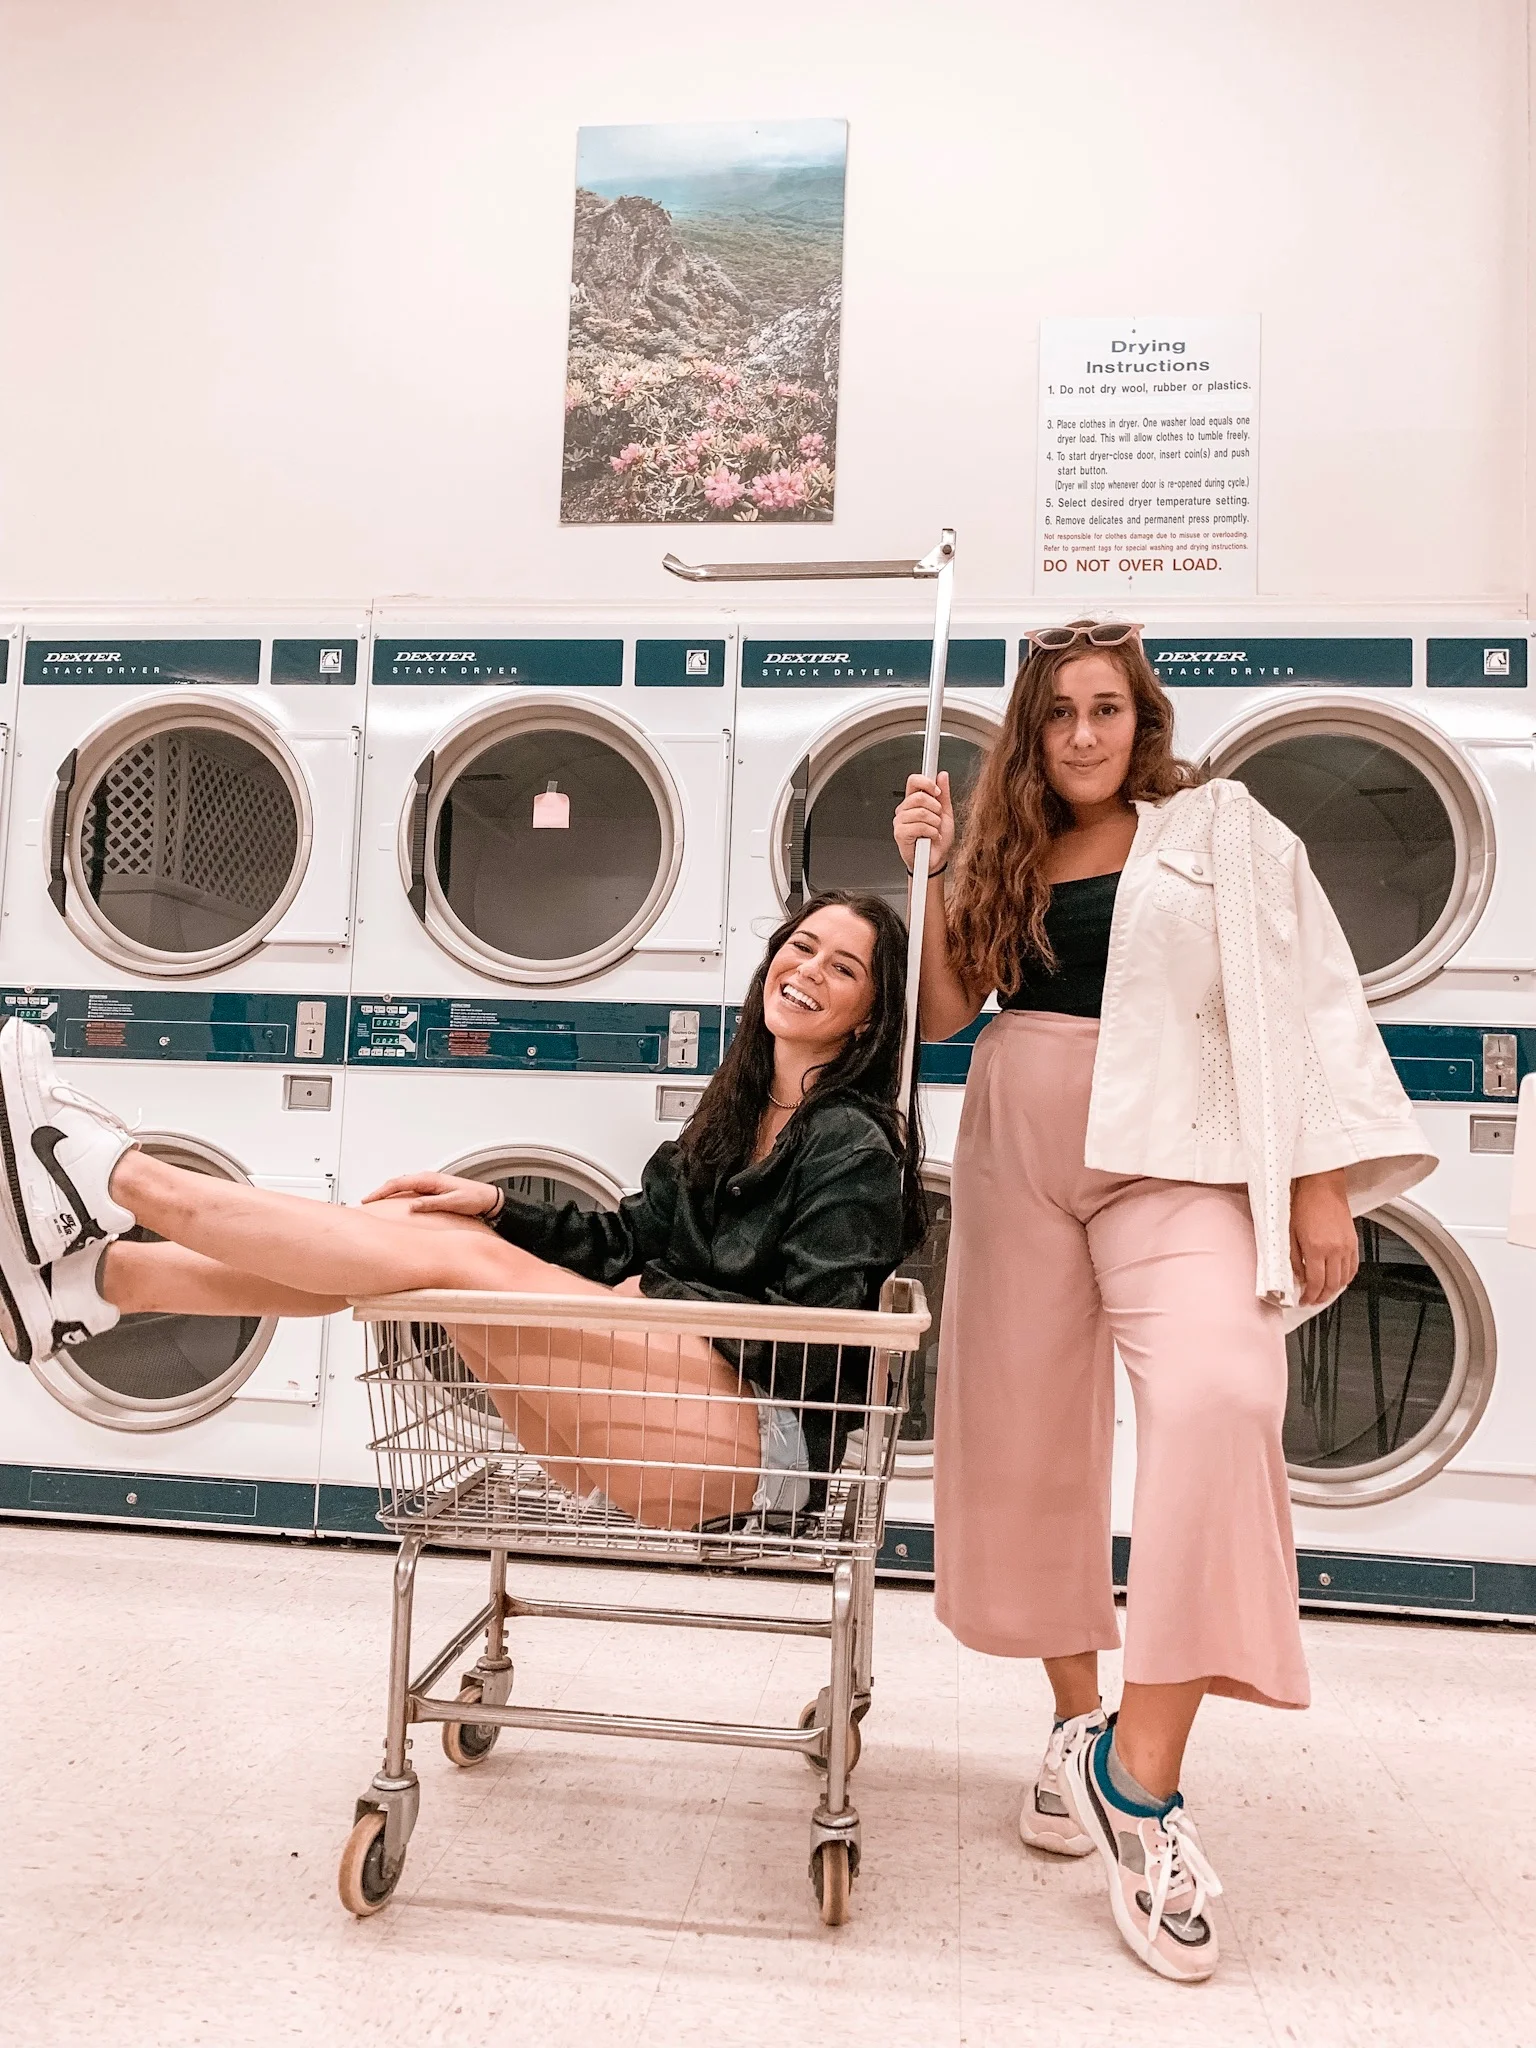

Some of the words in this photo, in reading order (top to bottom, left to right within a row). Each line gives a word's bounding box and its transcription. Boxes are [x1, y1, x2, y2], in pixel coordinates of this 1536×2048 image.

[1111, 340, 1186, 354] Drying
[1086, 359, 1210, 374] Instructions
[1048, 385, 1055, 394] 1.
[1060, 385, 1073, 394] Do
[1079, 385, 1095, 394] not
[1100, 384, 1116, 395] dry
[1122, 383, 1148, 394] wool,
[1153, 382, 1187, 392] rubber
[1192, 383, 1202, 391] or
[1208, 380, 1251, 392] plastics.
[1047, 420, 1053, 429] 3.
[1057, 420, 1076, 429] Place
[1080, 419, 1106, 428] clothes
[1109, 419, 1115, 428] in
[1118, 419, 1139, 429] dryer.
[1143, 417, 1157, 427] One
[1161, 417, 1186, 426] washer
[1190, 417, 1205, 426] load
[1209, 416, 1233, 427] equals
[1236, 417, 1250, 425] one
[1057, 434, 1076, 445] dryer
[1080, 434, 1097, 443] load.
[1100, 433, 1115, 442] This
[1119, 433, 1130, 442] will
[1134, 433, 1152, 442] allow
[1156, 432, 1183, 441] clothes
[1187, 432, 1194, 440] to
[1198, 431, 1223, 440] tumble
[1227, 430, 1250, 441] freely.
[1047, 452, 1053, 460] 4.
[1057, 452, 1065, 460] To
[1069, 452, 1086, 460] start
[1090, 451, 1133, 462] dryer-close
[1136, 450, 1156, 461] door,
[1159, 450, 1181, 459] insert
[1184, 448, 1210, 459] coin(s)
[1214, 448, 1228, 457] and
[1231, 448, 1250, 459] push
[1057, 466, 1076, 475] start
[1080, 466, 1107, 475] button.
[1055, 480, 1075, 491] (Dryer
[1078, 480, 1087, 489] will
[1091, 480, 1105, 491] stop
[1108, 480, 1138, 489] whenever
[1141, 479, 1156, 488] door
[1159, 479, 1164, 488] is
[1168, 478, 1201, 489] re-opened
[1205, 478, 1225, 489] during
[1228, 476, 1249, 488] cycle.)
[1045, 498, 1053, 507] 5.
[1058, 498, 1086, 507] Select
[1091, 498, 1124, 507] desired
[1129, 498, 1152, 508] dryer
[1156, 497, 1211, 507] temperature
[1216, 496, 1249, 506] setting.
[1045, 516, 1052, 525] 6.
[1056, 516, 1085, 525] Remove
[1089, 515, 1123, 524] delicates
[1127, 515, 1140, 524] and
[1144, 515, 1184, 525] permanent
[1189, 516, 1210, 525] press
[1213, 513, 1249, 524] promptly.
[1212, 531, 1248, 539] overloading.
[1043, 560, 1067, 572] DO
[1076, 559, 1110, 571] NOT
[1119, 558, 1164, 572] OVER
[1173, 558, 1222, 571] LOAD.
[45, 653, 121, 662] DEXTER
[393, 652, 476, 661] DEXTER
[763, 653, 849, 663] DEXTER
[1154, 651, 1247, 662] DEXTER
[834, 668, 894, 676] DRYER
[1154, 667, 1215, 675] STACK
[1231, 667, 1296, 675] DRYER
